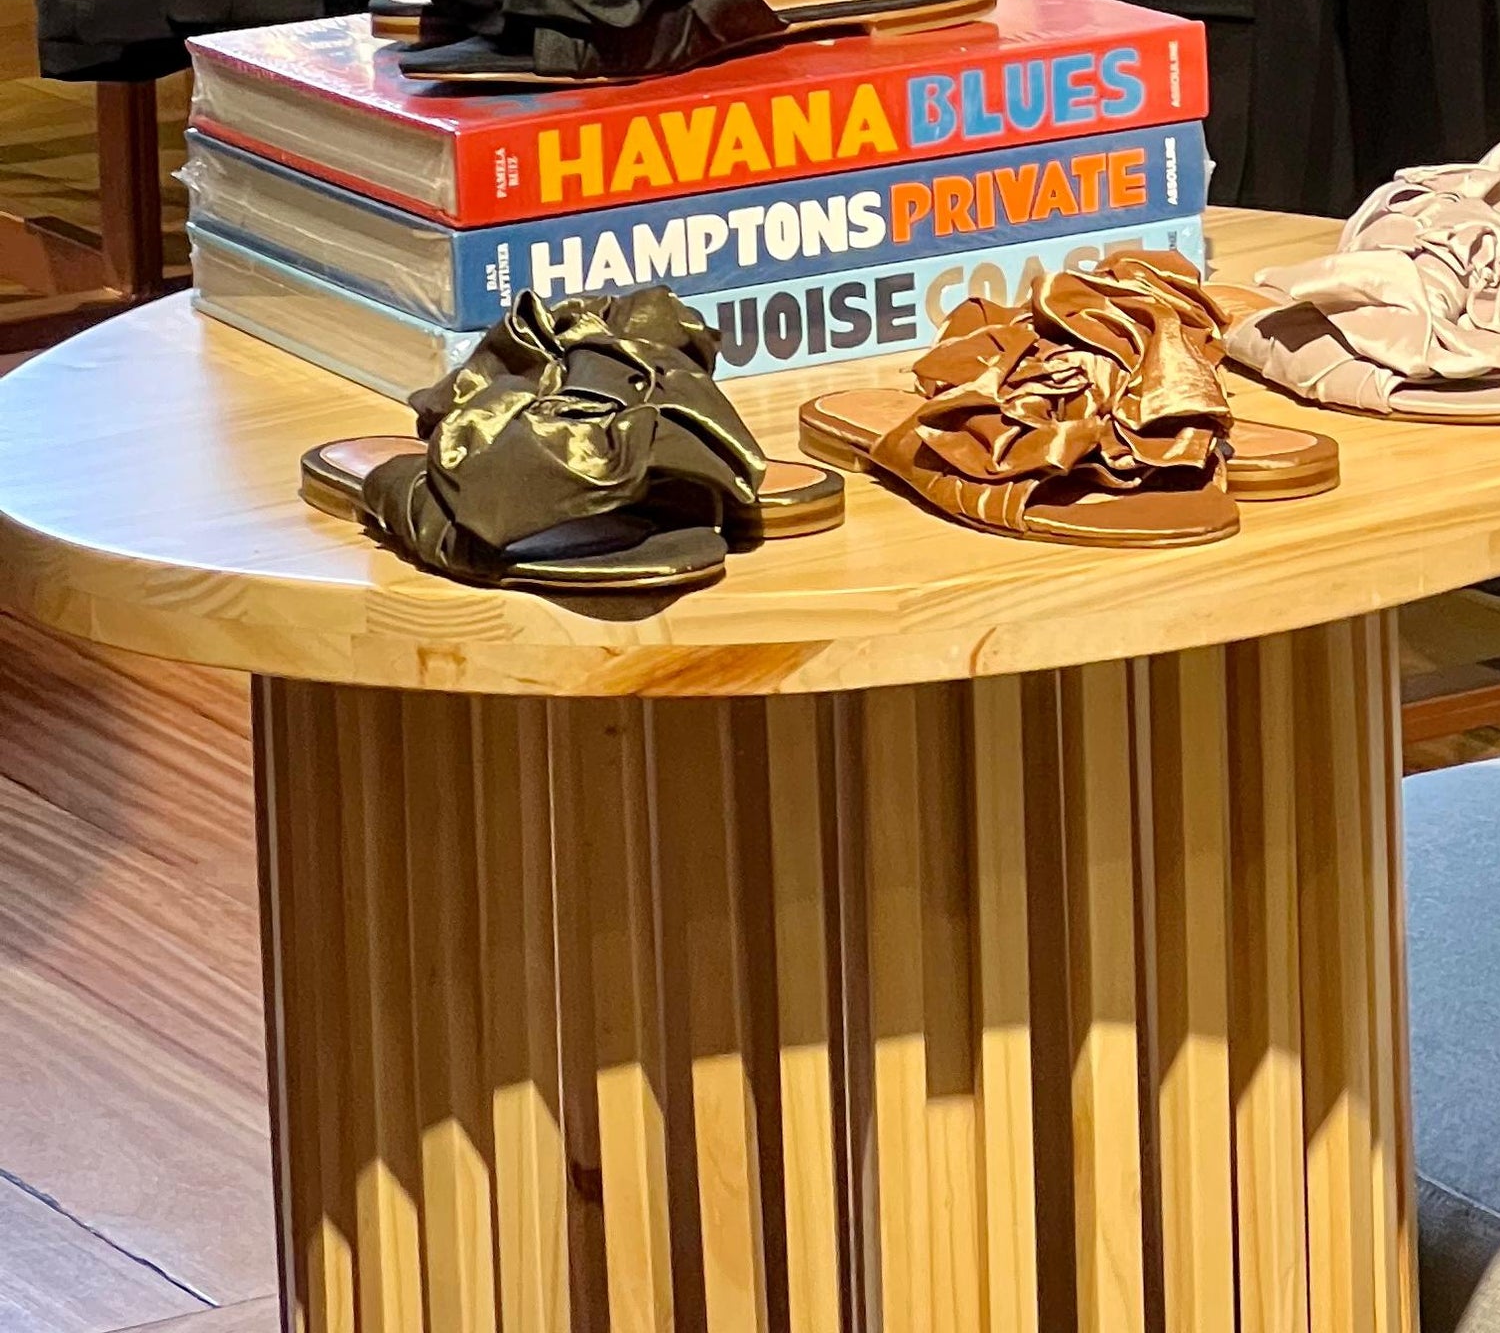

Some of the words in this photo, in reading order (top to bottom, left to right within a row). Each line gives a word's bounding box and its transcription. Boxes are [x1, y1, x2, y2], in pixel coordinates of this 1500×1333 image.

[1168, 40, 1181, 108] ASSOULINE
[538, 83, 898, 203] HAVANA
[907, 46, 1145, 149] BLUES
[495, 147, 508, 198] PAMELA
[1165, 137, 1178, 206] ASSOULINE
[531, 189, 886, 299] HAMPTONS
[890, 147, 1147, 244] PRIVATE
